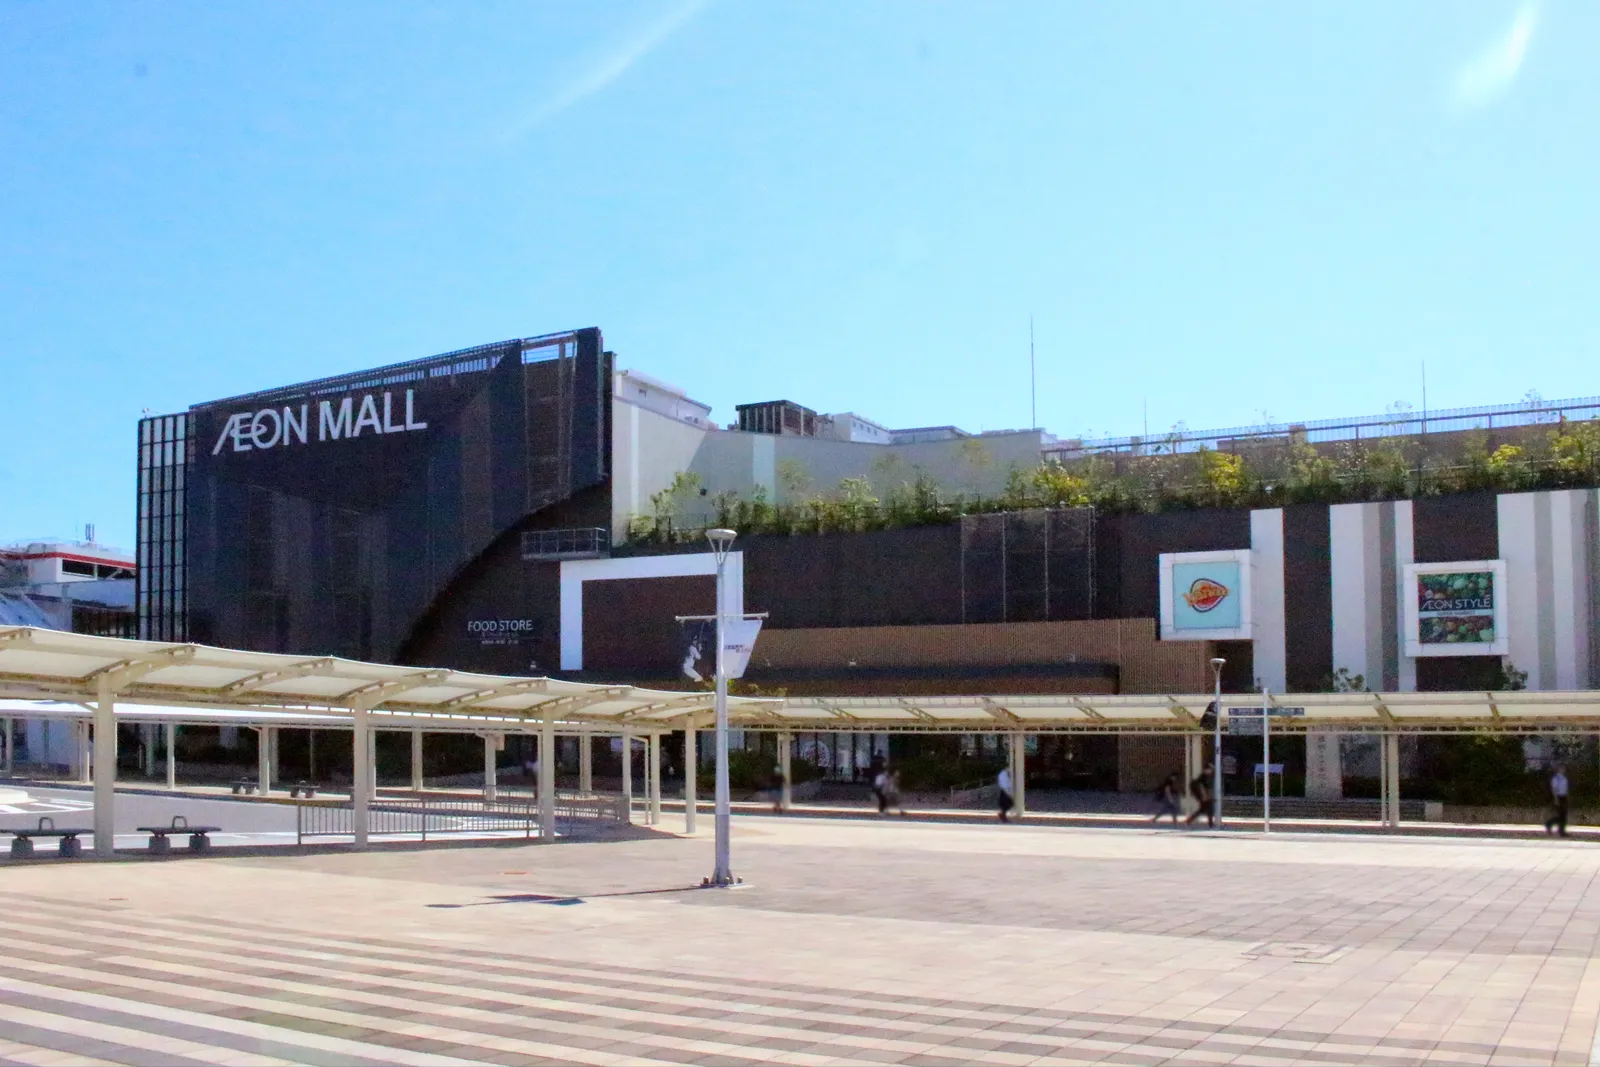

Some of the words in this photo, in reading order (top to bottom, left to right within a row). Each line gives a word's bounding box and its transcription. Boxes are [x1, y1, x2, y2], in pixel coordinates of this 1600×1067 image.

[319, 389, 428, 441] MALL
[467, 620, 498, 632] FOOD
[499, 619, 534, 631] STORE
